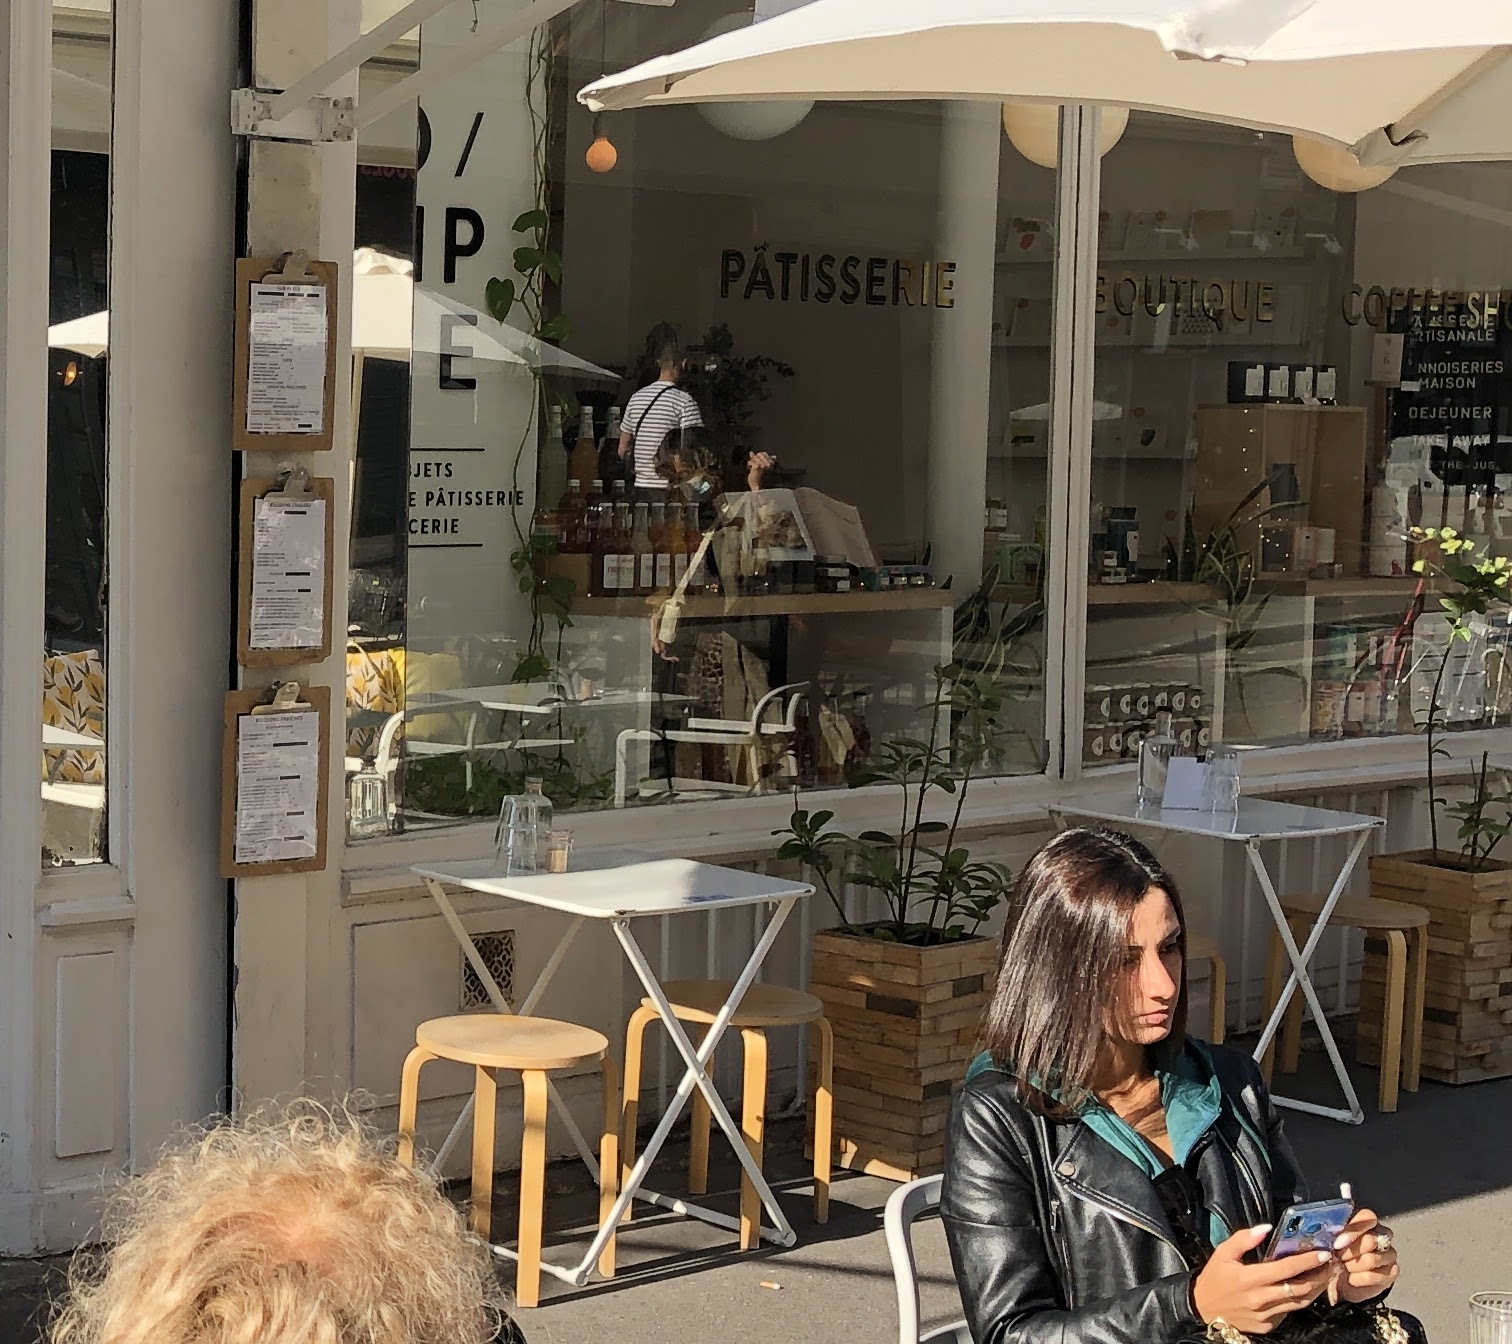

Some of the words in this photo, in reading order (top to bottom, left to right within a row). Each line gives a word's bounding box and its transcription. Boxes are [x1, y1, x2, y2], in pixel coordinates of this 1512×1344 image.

[720, 243, 957, 309] PÂTISSERIE
[1342, 282, 1460, 328] COFFEE
[1418, 376, 1477, 390] MAISON
[1408, 406, 1492, 420] DEJEUNER
[425, 486, 524, 507] PÂTISSERIE
